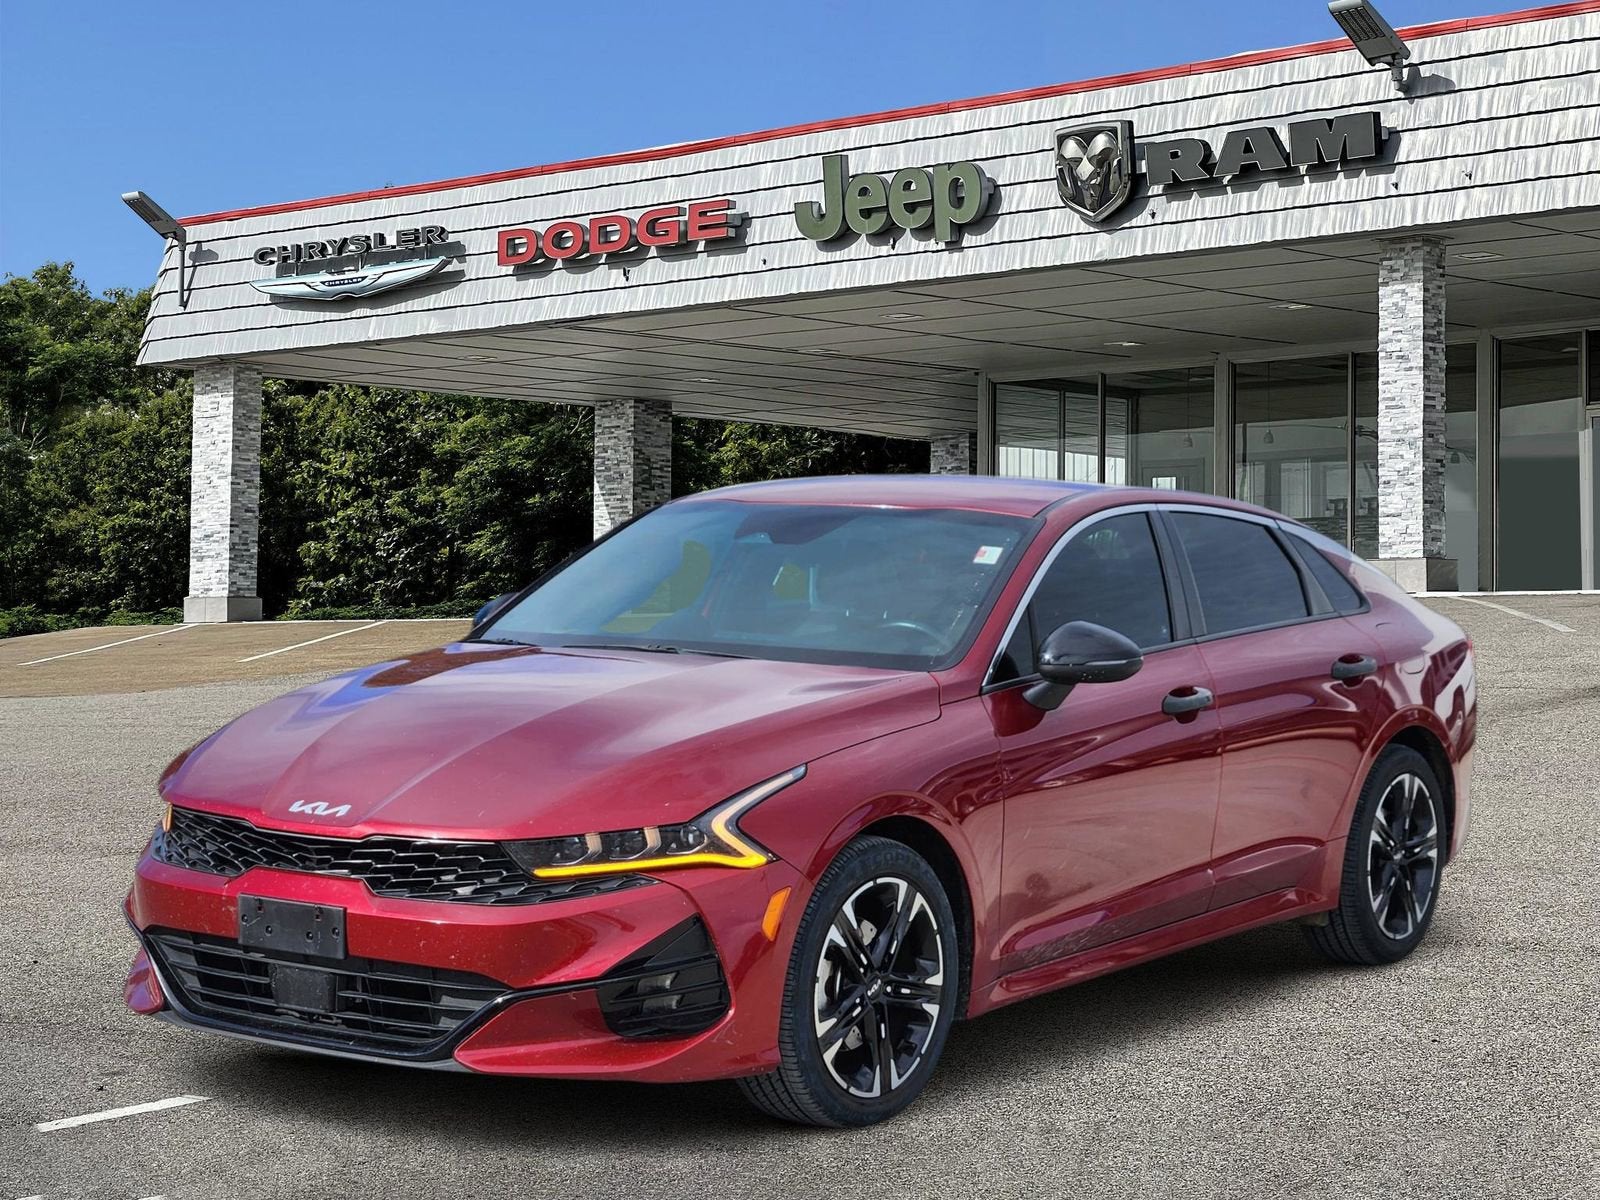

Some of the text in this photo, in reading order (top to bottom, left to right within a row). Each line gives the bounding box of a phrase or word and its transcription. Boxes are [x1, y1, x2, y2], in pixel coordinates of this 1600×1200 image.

[1145, 111, 1381, 186] RAM
[794, 155, 986, 242] Jeep
[253, 225, 449, 266] CHRYSLER
[497, 199, 735, 266] DODGE
[324, 278, 363, 286] CHRYSLER
